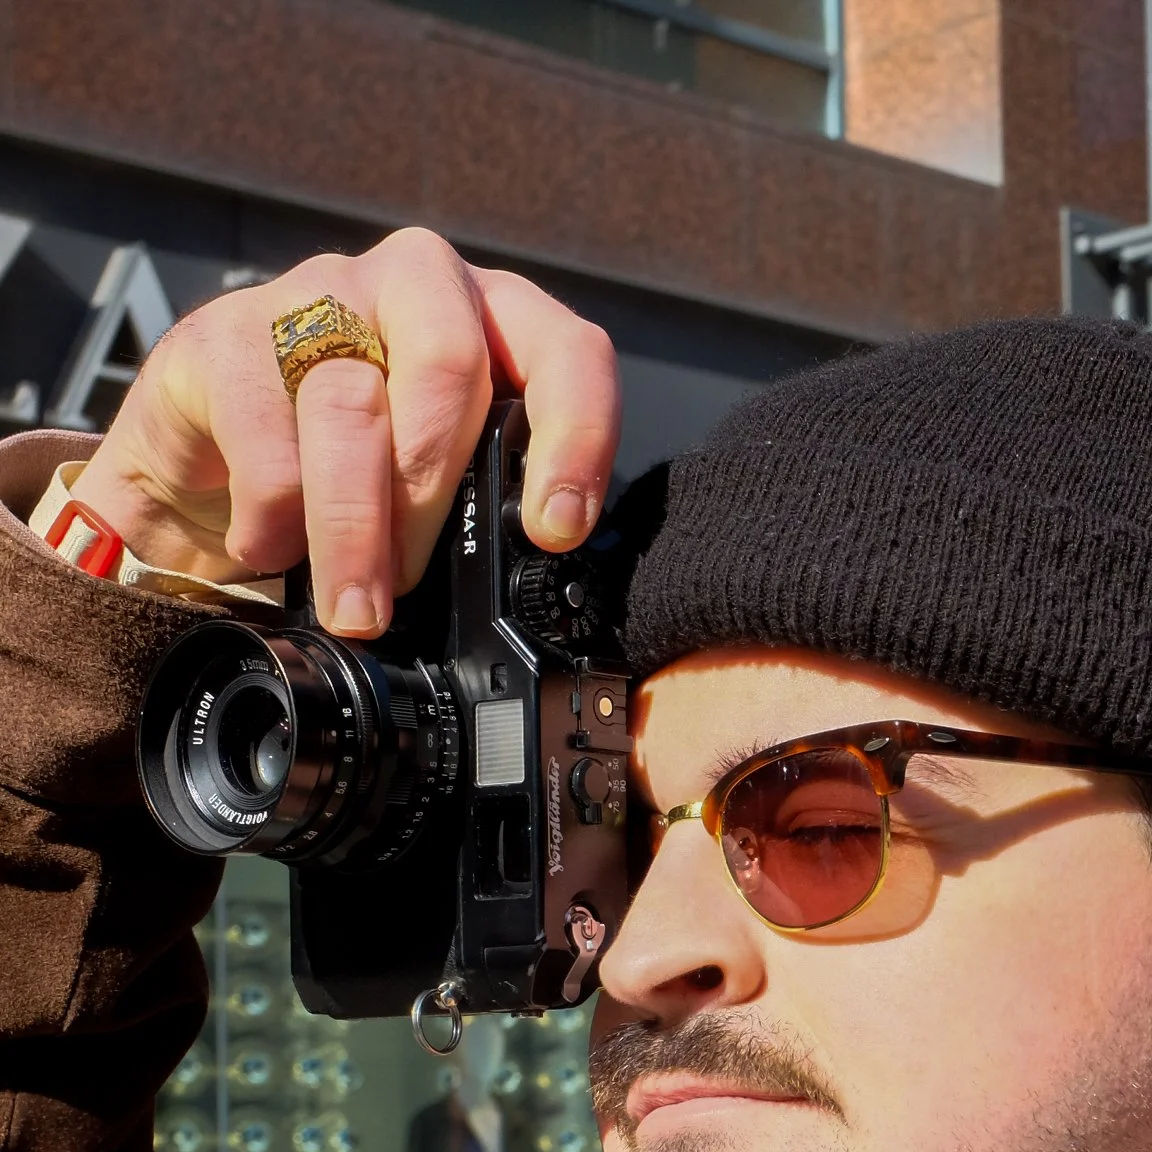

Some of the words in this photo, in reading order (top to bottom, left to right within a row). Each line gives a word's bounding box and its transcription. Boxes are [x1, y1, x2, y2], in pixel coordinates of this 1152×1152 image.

[463, 457, 477, 555] ESSA-R
[192, 691, 215, 746] ULTRON
[344, 729, 355, 739] 11
[343, 755, 353, 764] 8
[612, 757, 620, 771] 50
[335, 780, 348, 796] 5.6
[612, 779, 620, 792] 35
[619, 779, 627, 793] 90
[612, 800, 621, 814] 75
[325, 811, 335, 819] 4
